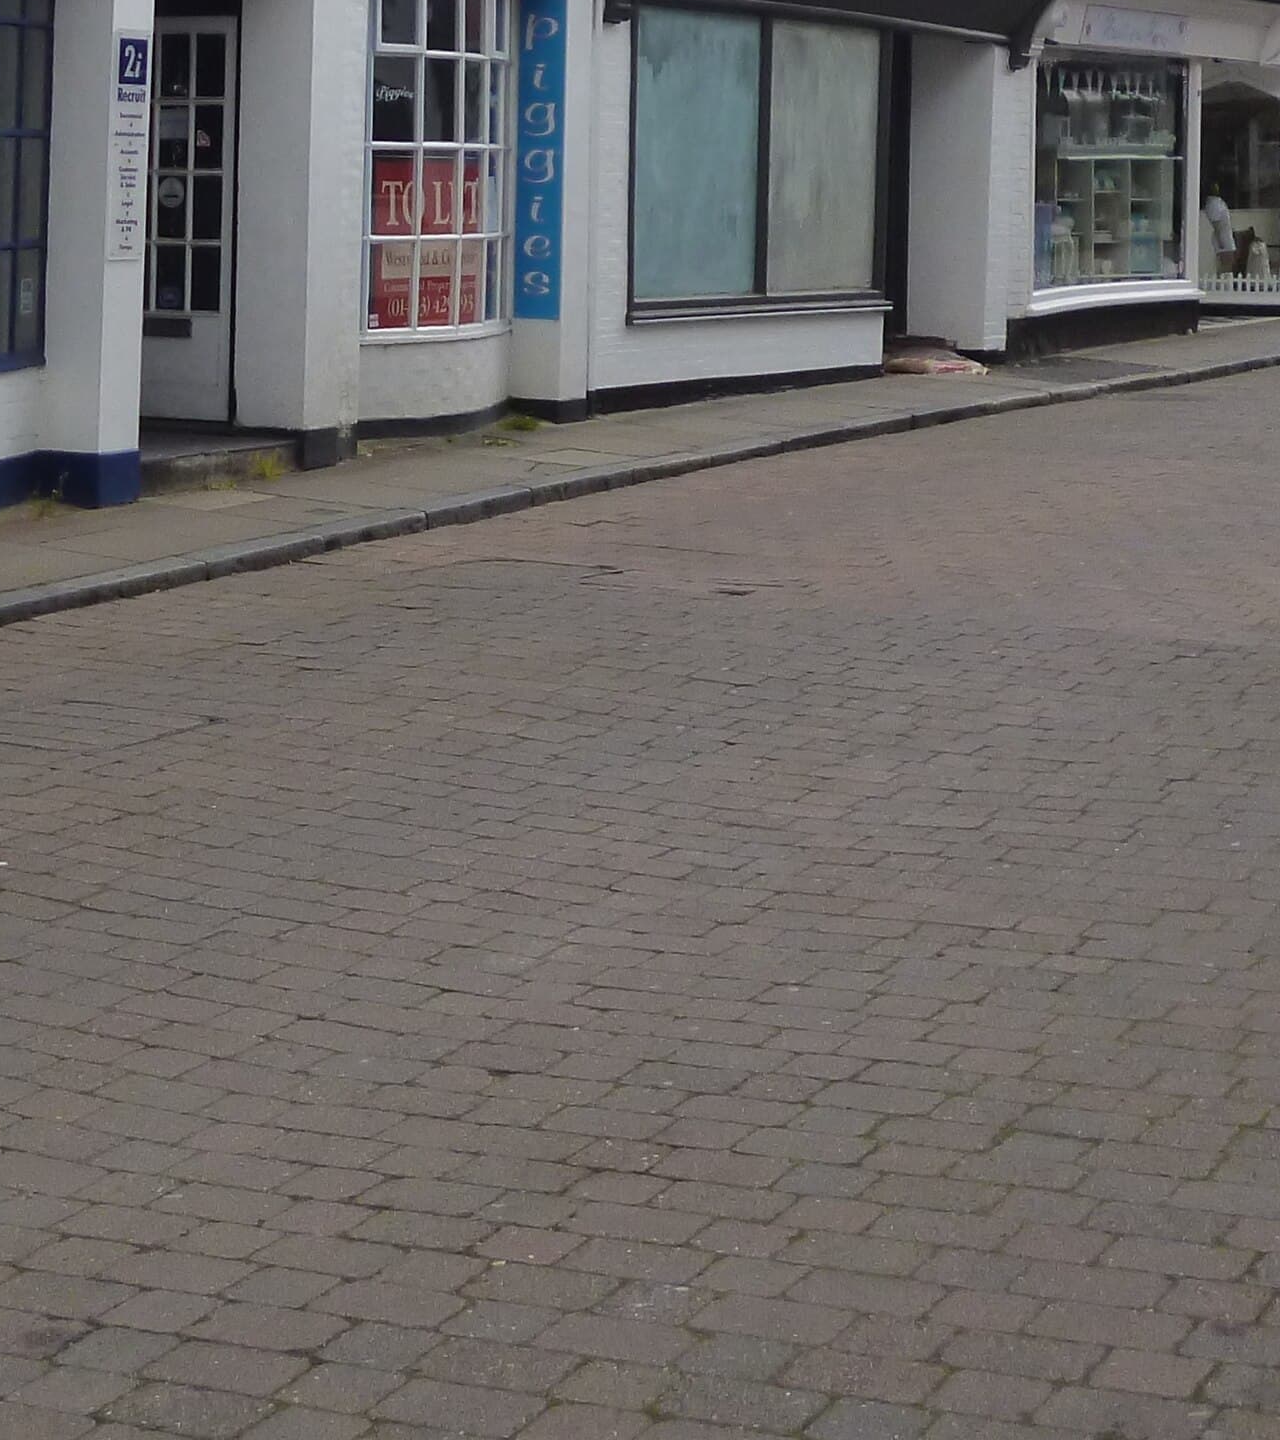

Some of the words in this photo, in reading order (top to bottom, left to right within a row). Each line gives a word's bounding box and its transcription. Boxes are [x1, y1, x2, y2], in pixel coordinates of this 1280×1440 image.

[123, 44, 143, 78] 2i
[117, 87, 146, 103] Recruit
[376, 85, 415, 102] Piggies
[523, 13, 559, 296] piggies
[381, 180, 426, 226] TO
